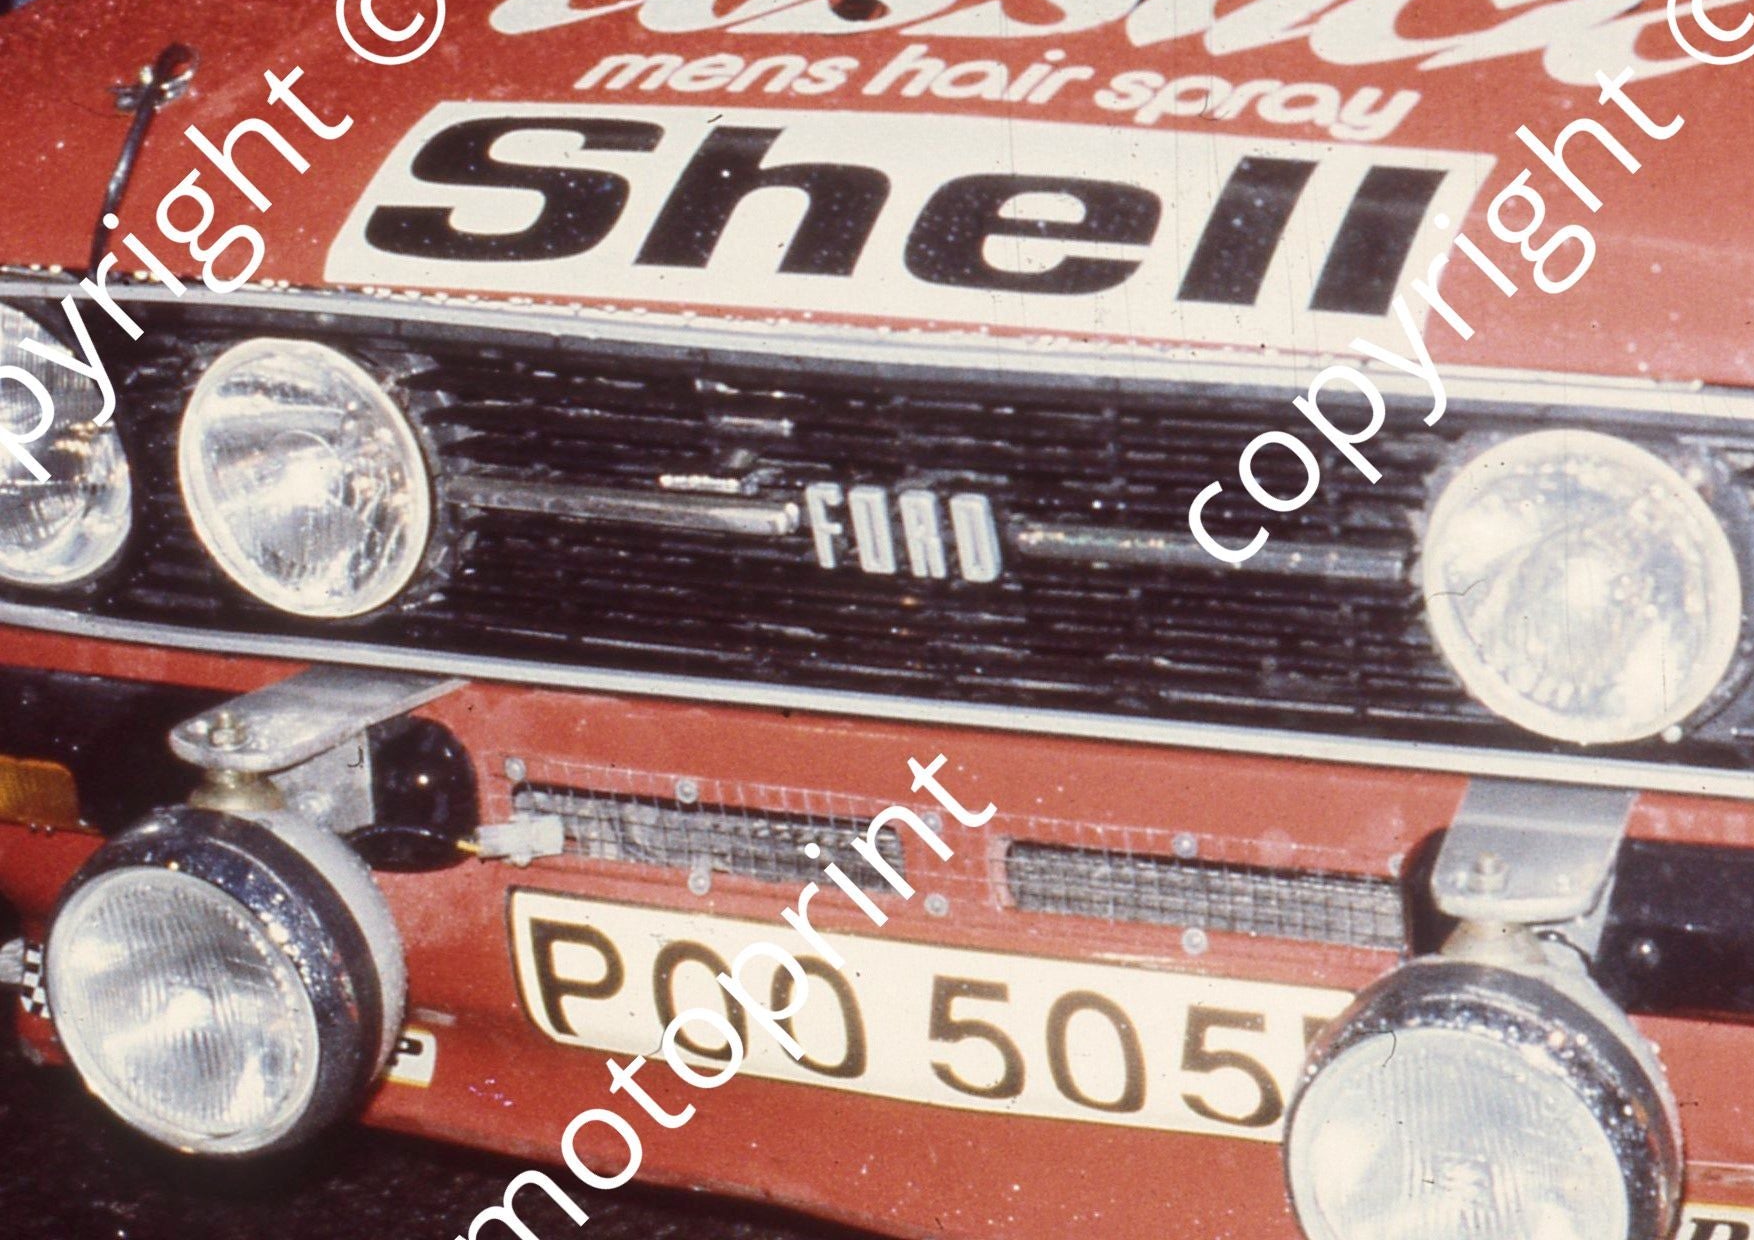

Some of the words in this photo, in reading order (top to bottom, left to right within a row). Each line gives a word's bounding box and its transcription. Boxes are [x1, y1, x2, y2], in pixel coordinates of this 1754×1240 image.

[573, 51, 860, 98] mens
[862, 44, 1094, 106] hair
[1094, 64, 1422, 142] spray
[364, 115, 1452, 317] Shell
[804, 482, 1001, 583] FORD
[528, 917, 868, 1081] POO
